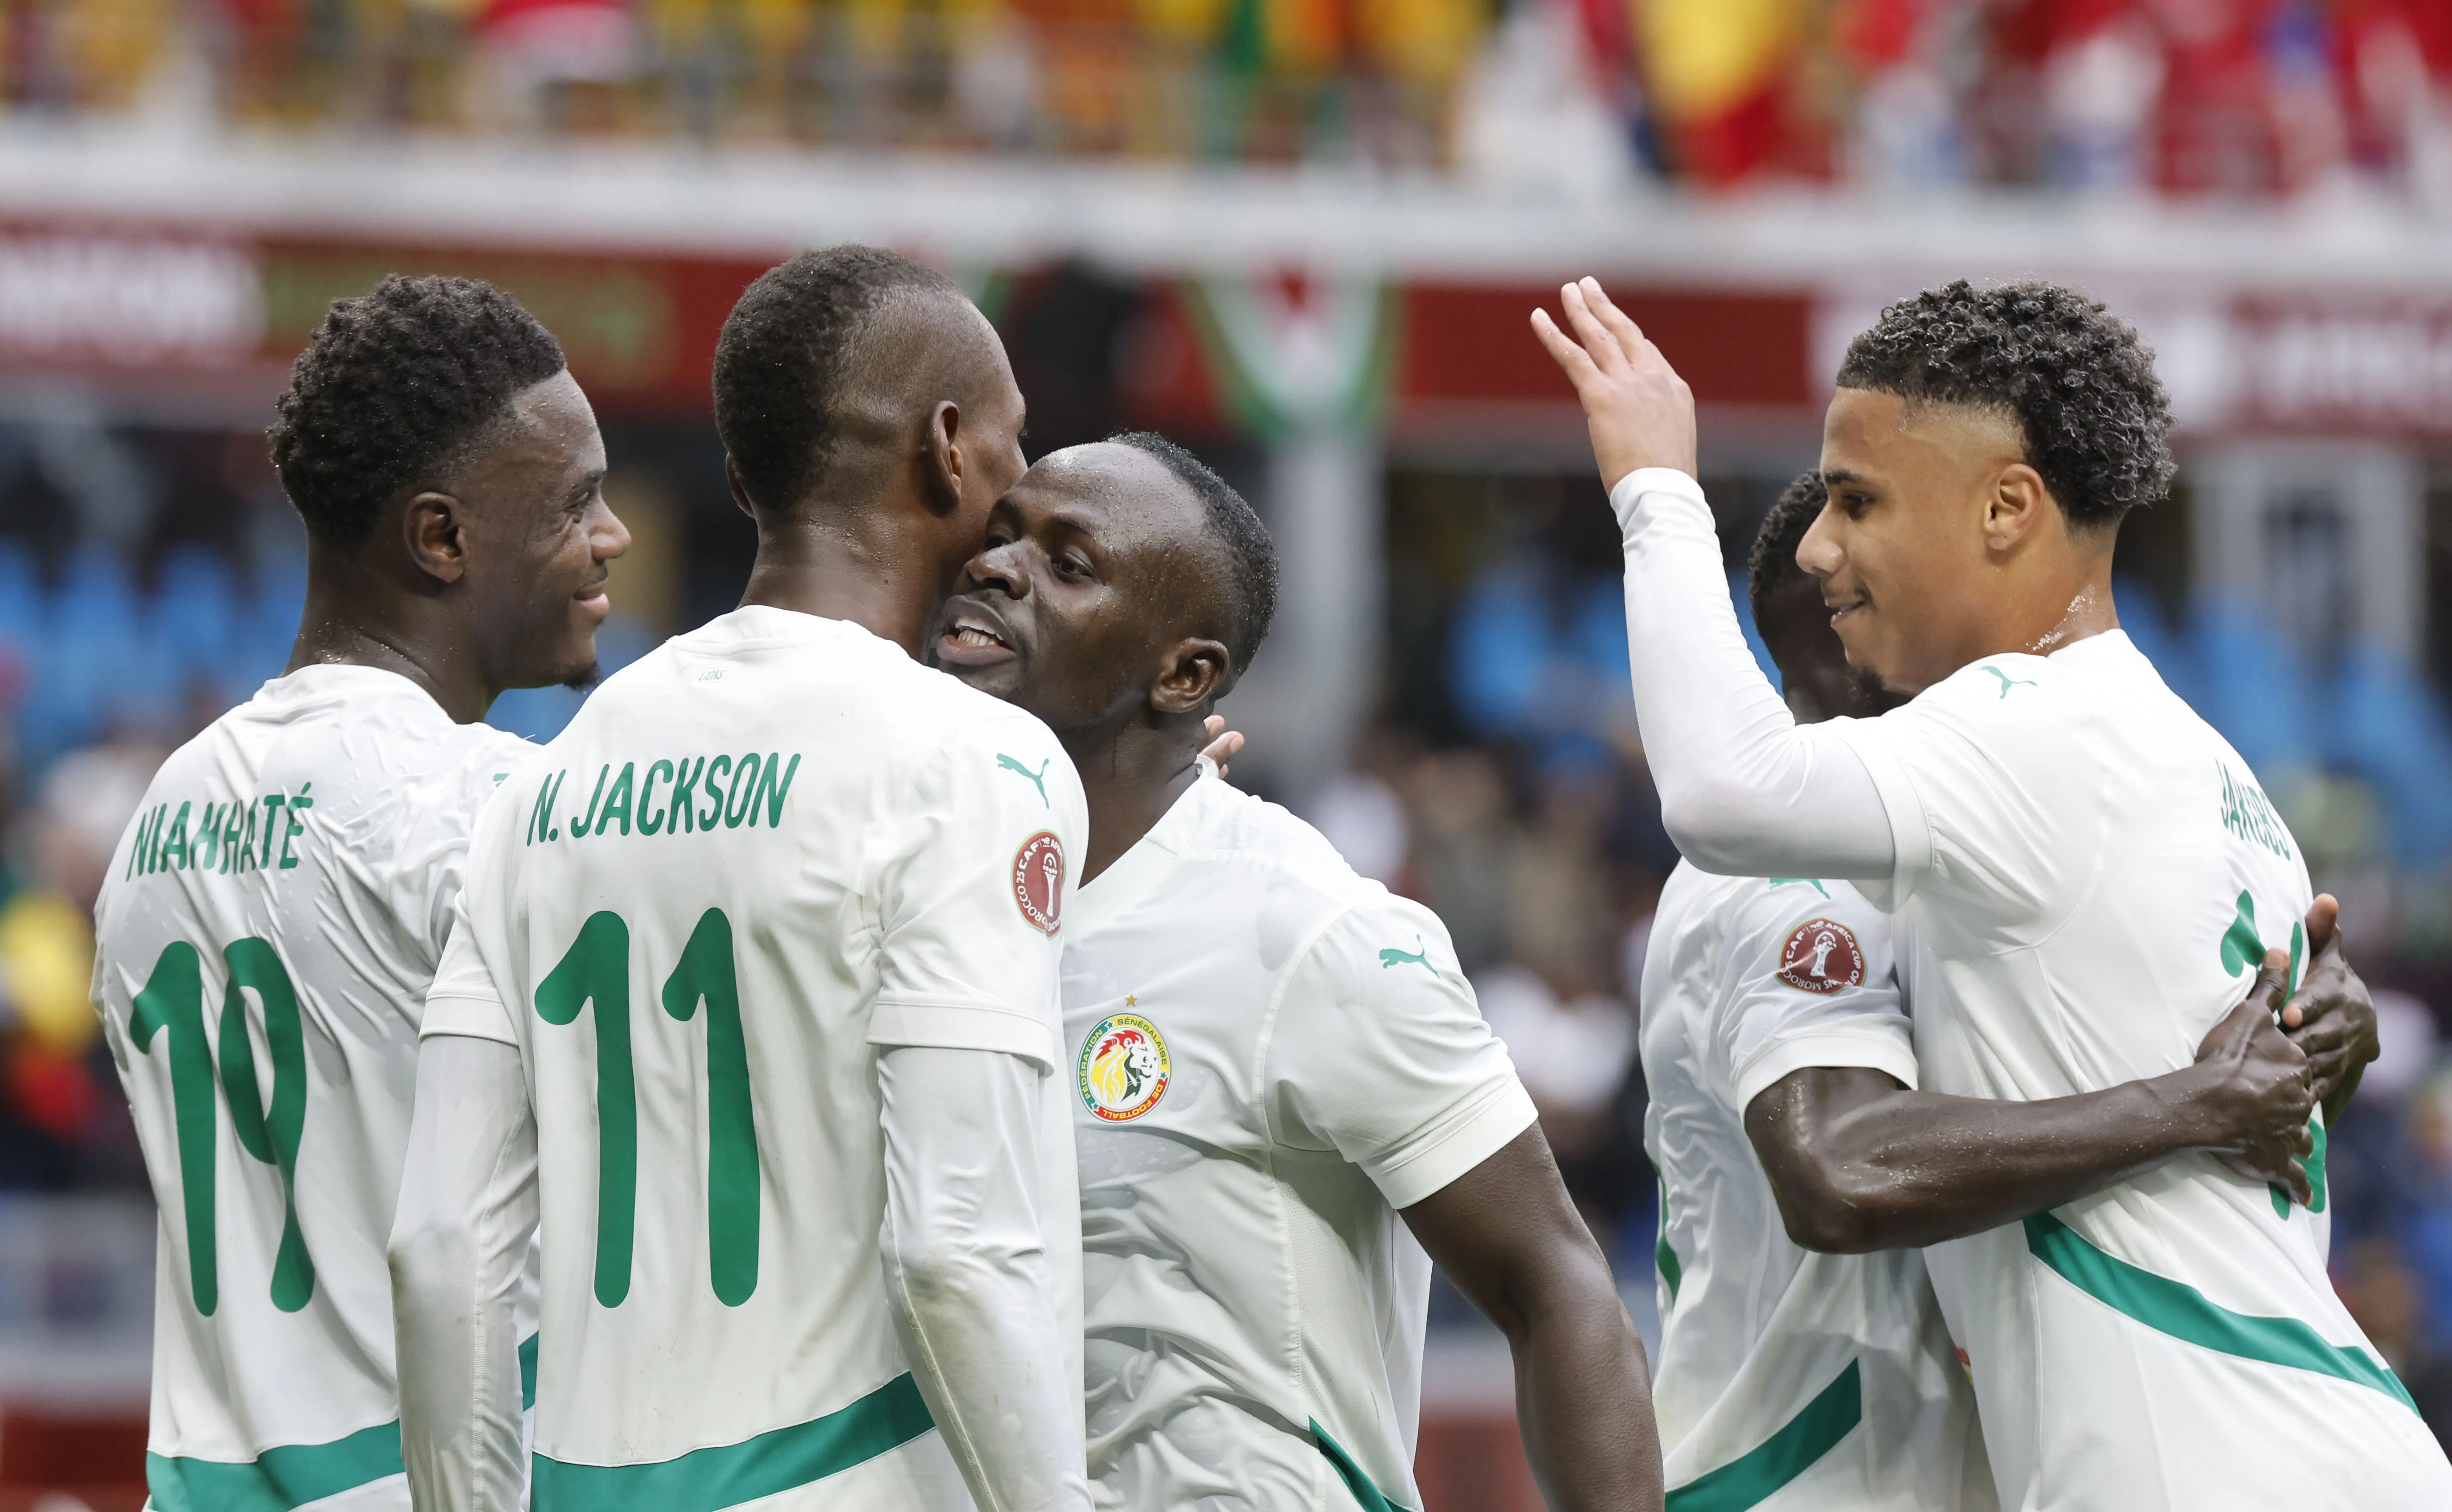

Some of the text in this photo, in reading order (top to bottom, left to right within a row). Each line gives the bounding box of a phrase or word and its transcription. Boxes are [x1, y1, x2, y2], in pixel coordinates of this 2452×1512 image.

[527, 752, 801, 847] N. JACKSON
[1016, 870, 1025, 884] 25
[1019, 841, 1038, 870] CAF
[1786, 931, 1804, 959] CAF
[1826, 922, 1855, 949] AFRICA
[1852, 950, 1861, 969] CUP
[534, 907, 760, 1308] 11
[1079, 1017, 1167, 1119] FÉDÉRATION SÉNÉGALAISE DE FOOTBALL
[130, 936, 315, 1317] 19
